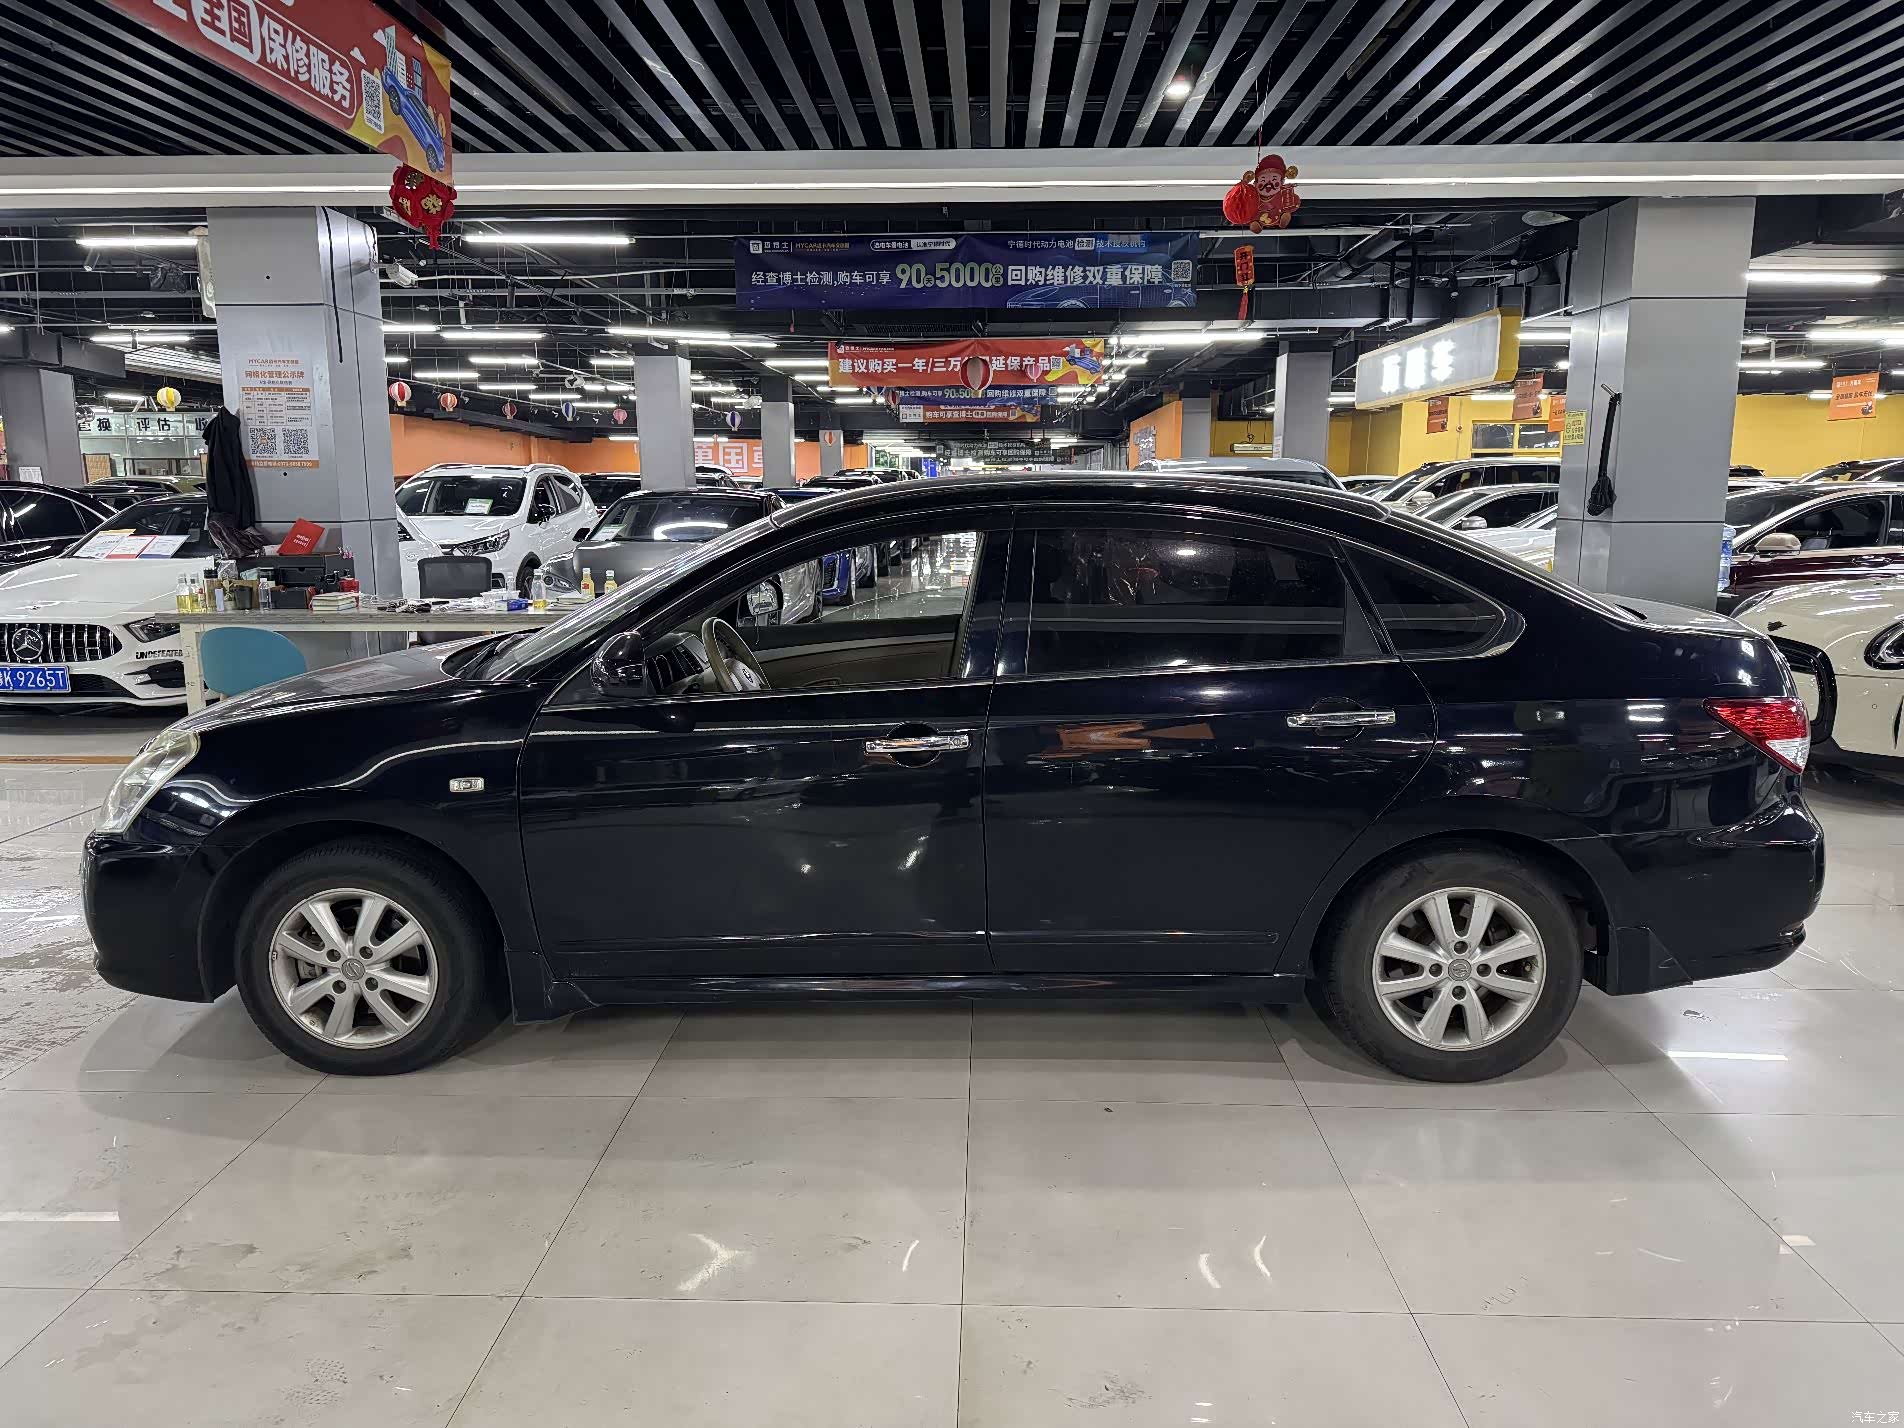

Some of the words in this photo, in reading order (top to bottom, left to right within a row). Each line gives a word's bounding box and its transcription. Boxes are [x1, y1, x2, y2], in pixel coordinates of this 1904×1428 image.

[1007, 264, 1163, 285] 回购维修双重保障
[838, 357, 1051, 374] 建议购买一年/三万延保产品
[136, 417, 171, 432] 评估
